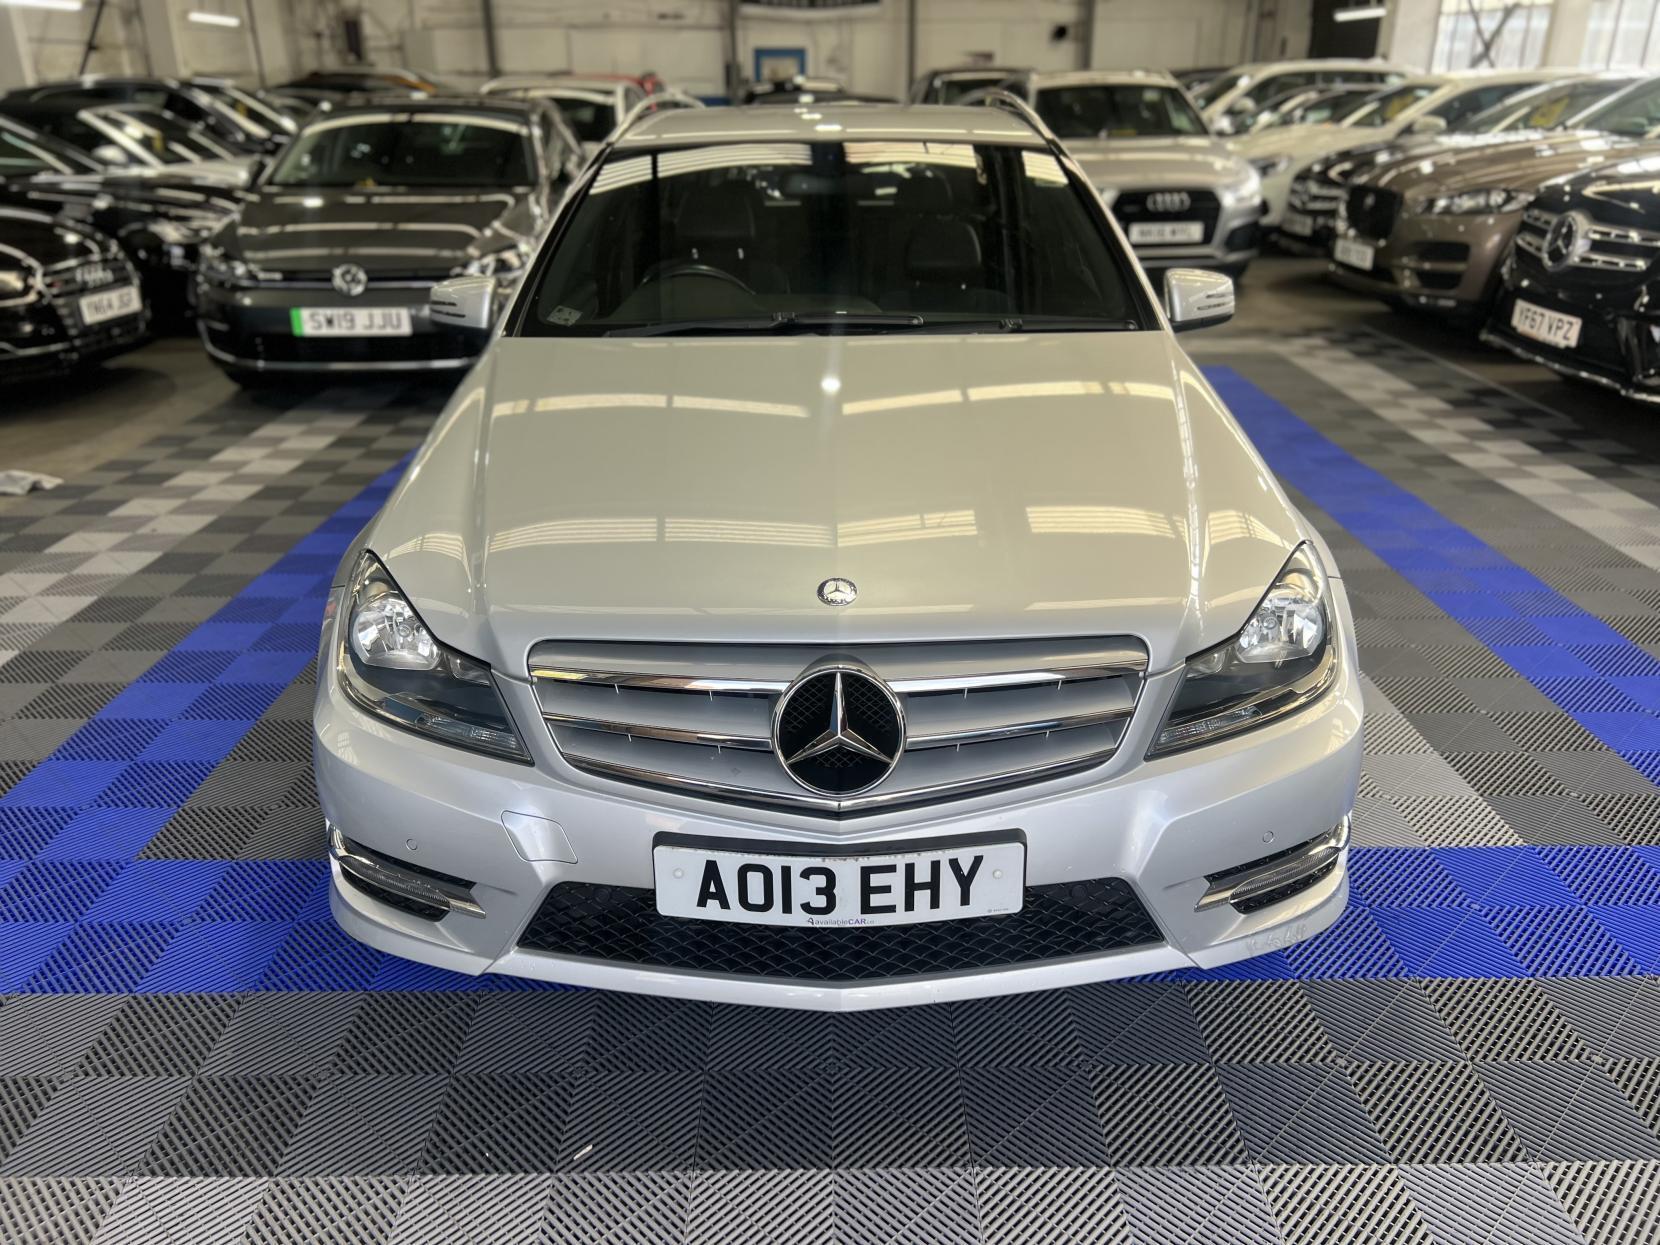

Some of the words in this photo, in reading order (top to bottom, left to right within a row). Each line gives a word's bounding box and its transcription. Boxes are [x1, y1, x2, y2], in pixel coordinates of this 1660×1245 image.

[309, 312, 357, 331] SW19
[363, 311, 403, 331] JJU
[1518, 307, 1546, 332] YF67
[1547, 315, 1575, 341] VPZ
[696, 859, 838, 916] AO13
[860, 855, 984, 915] EHY
